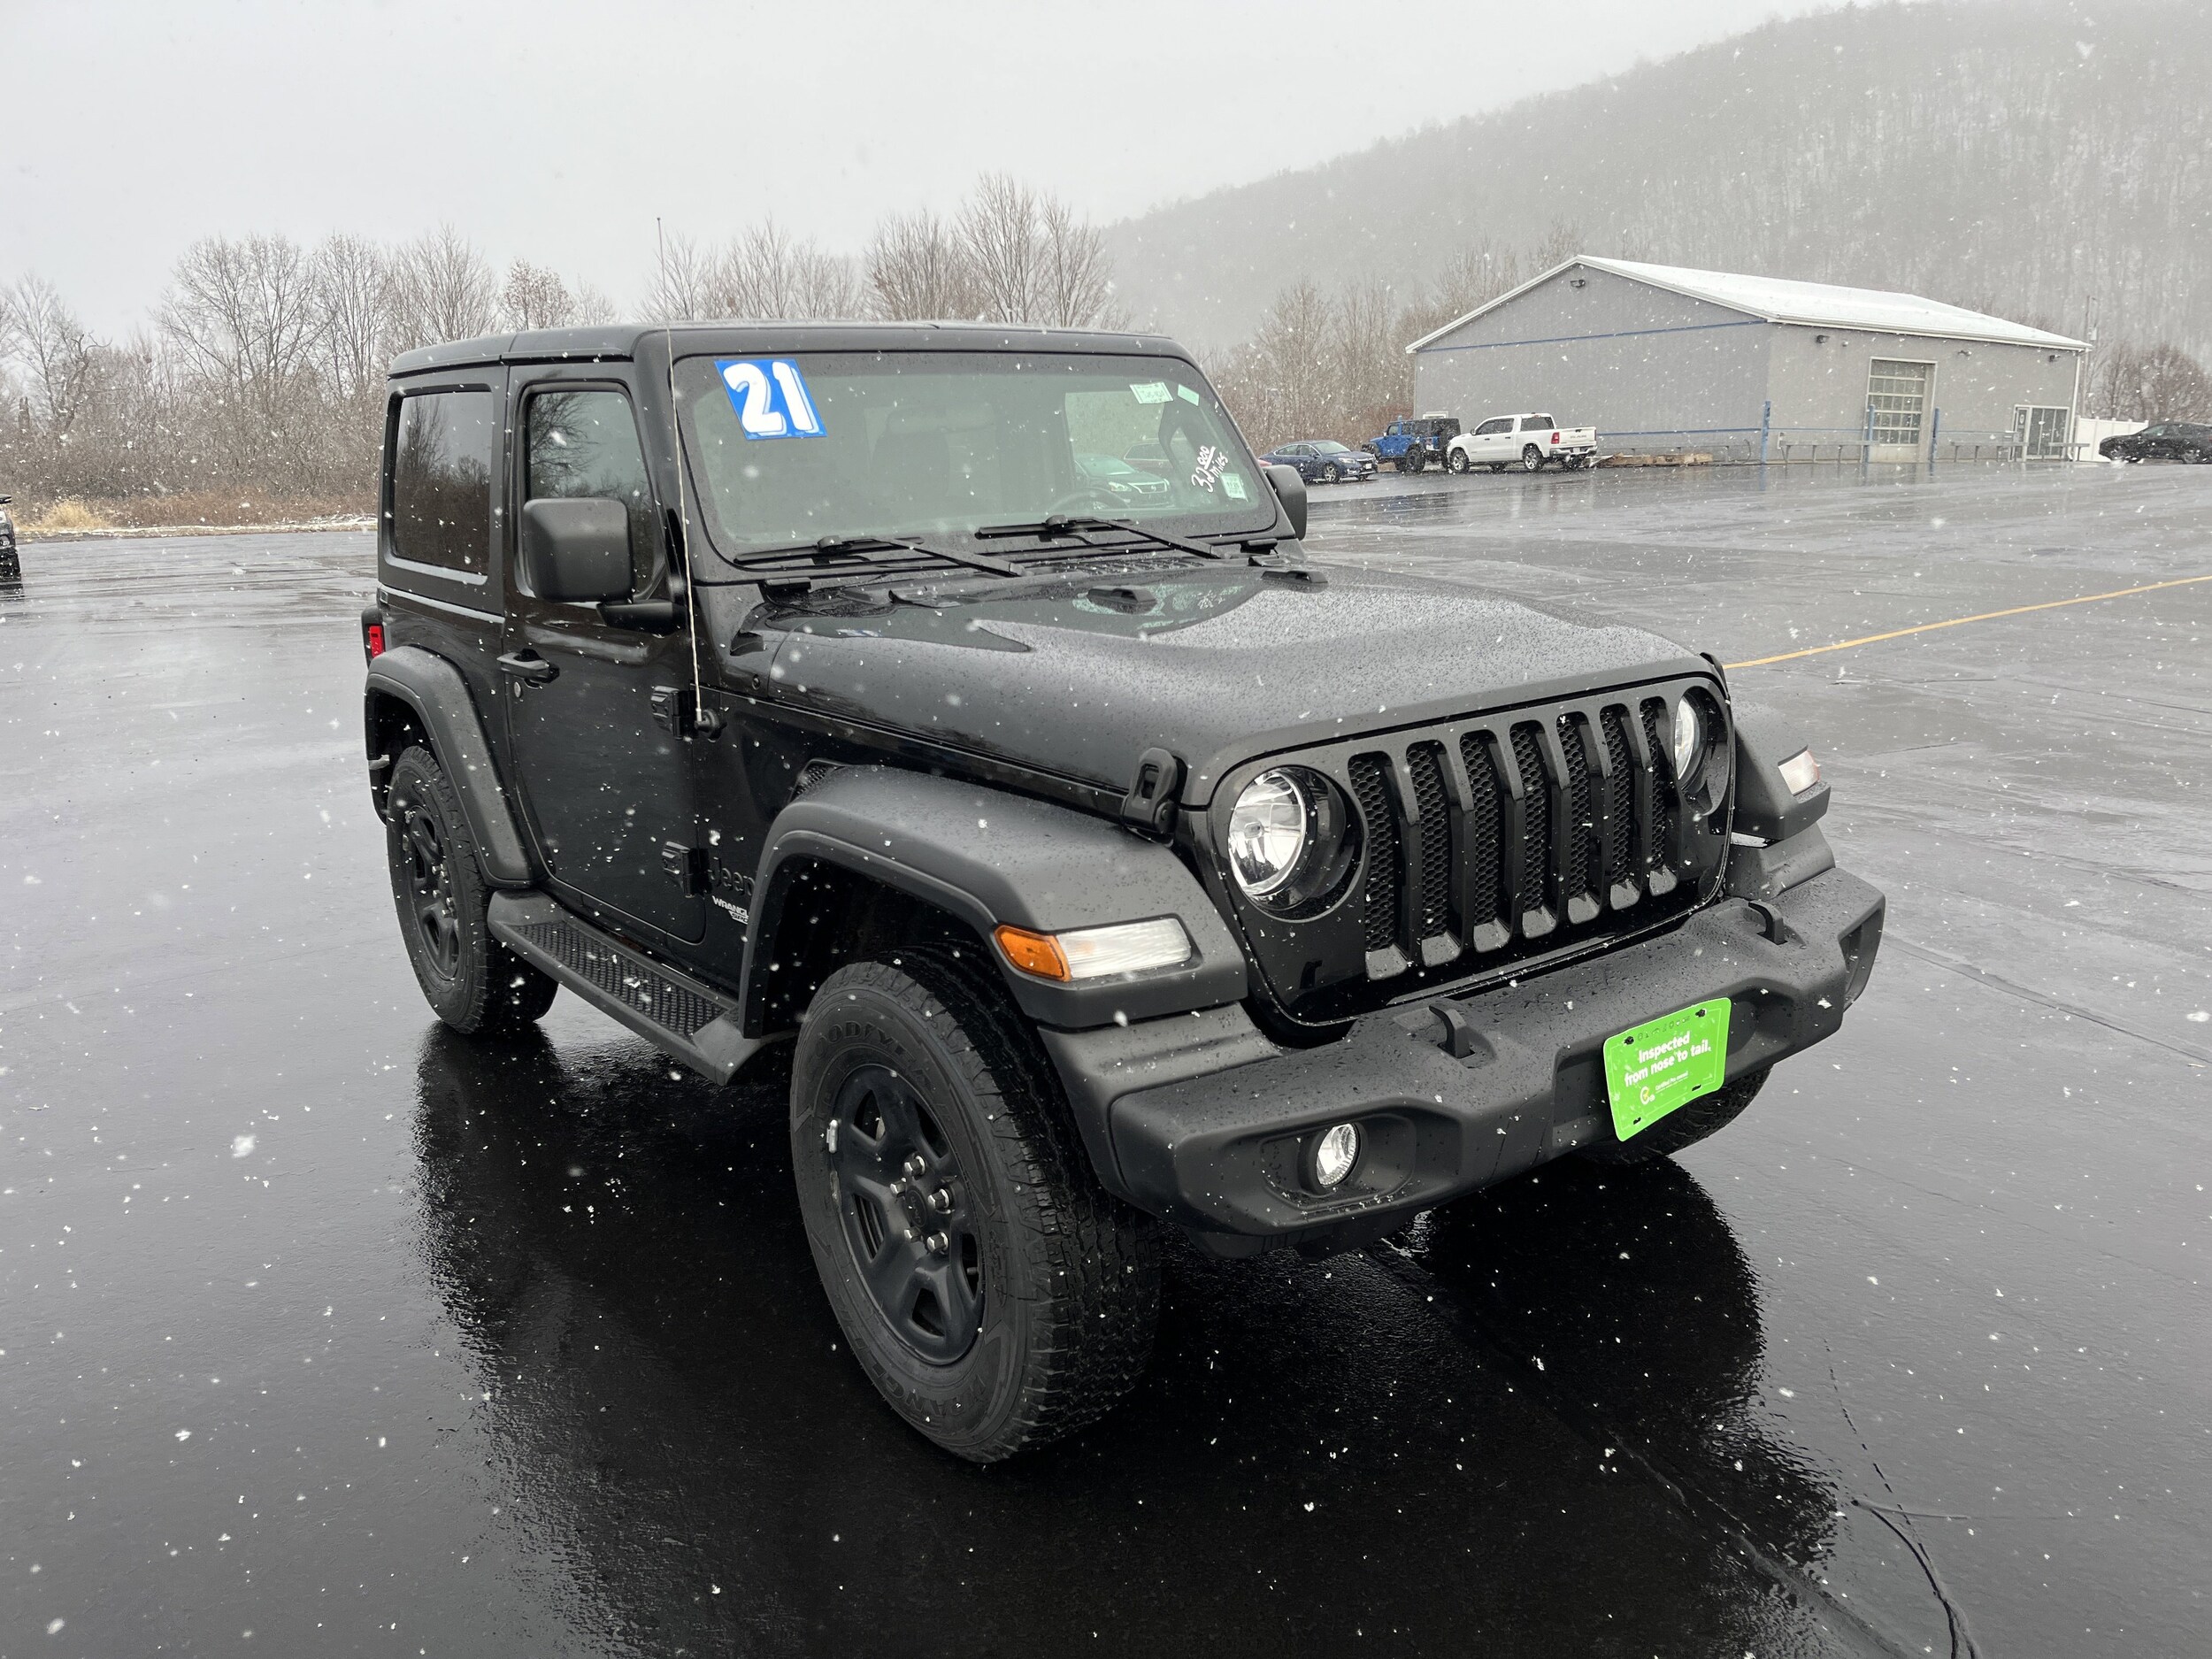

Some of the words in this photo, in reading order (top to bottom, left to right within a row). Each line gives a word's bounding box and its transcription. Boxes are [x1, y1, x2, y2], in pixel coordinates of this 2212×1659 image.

[723, 361, 819, 436] 21
[707, 856, 756, 896] Jeep
[711, 895, 749, 918] WRANGL
[1639, 1031, 1691, 1064] Inspected
[1624, 1067, 1648, 1087] from
[1650, 1055, 1675, 1075] nose
[1677, 1049, 1688, 1063] to
